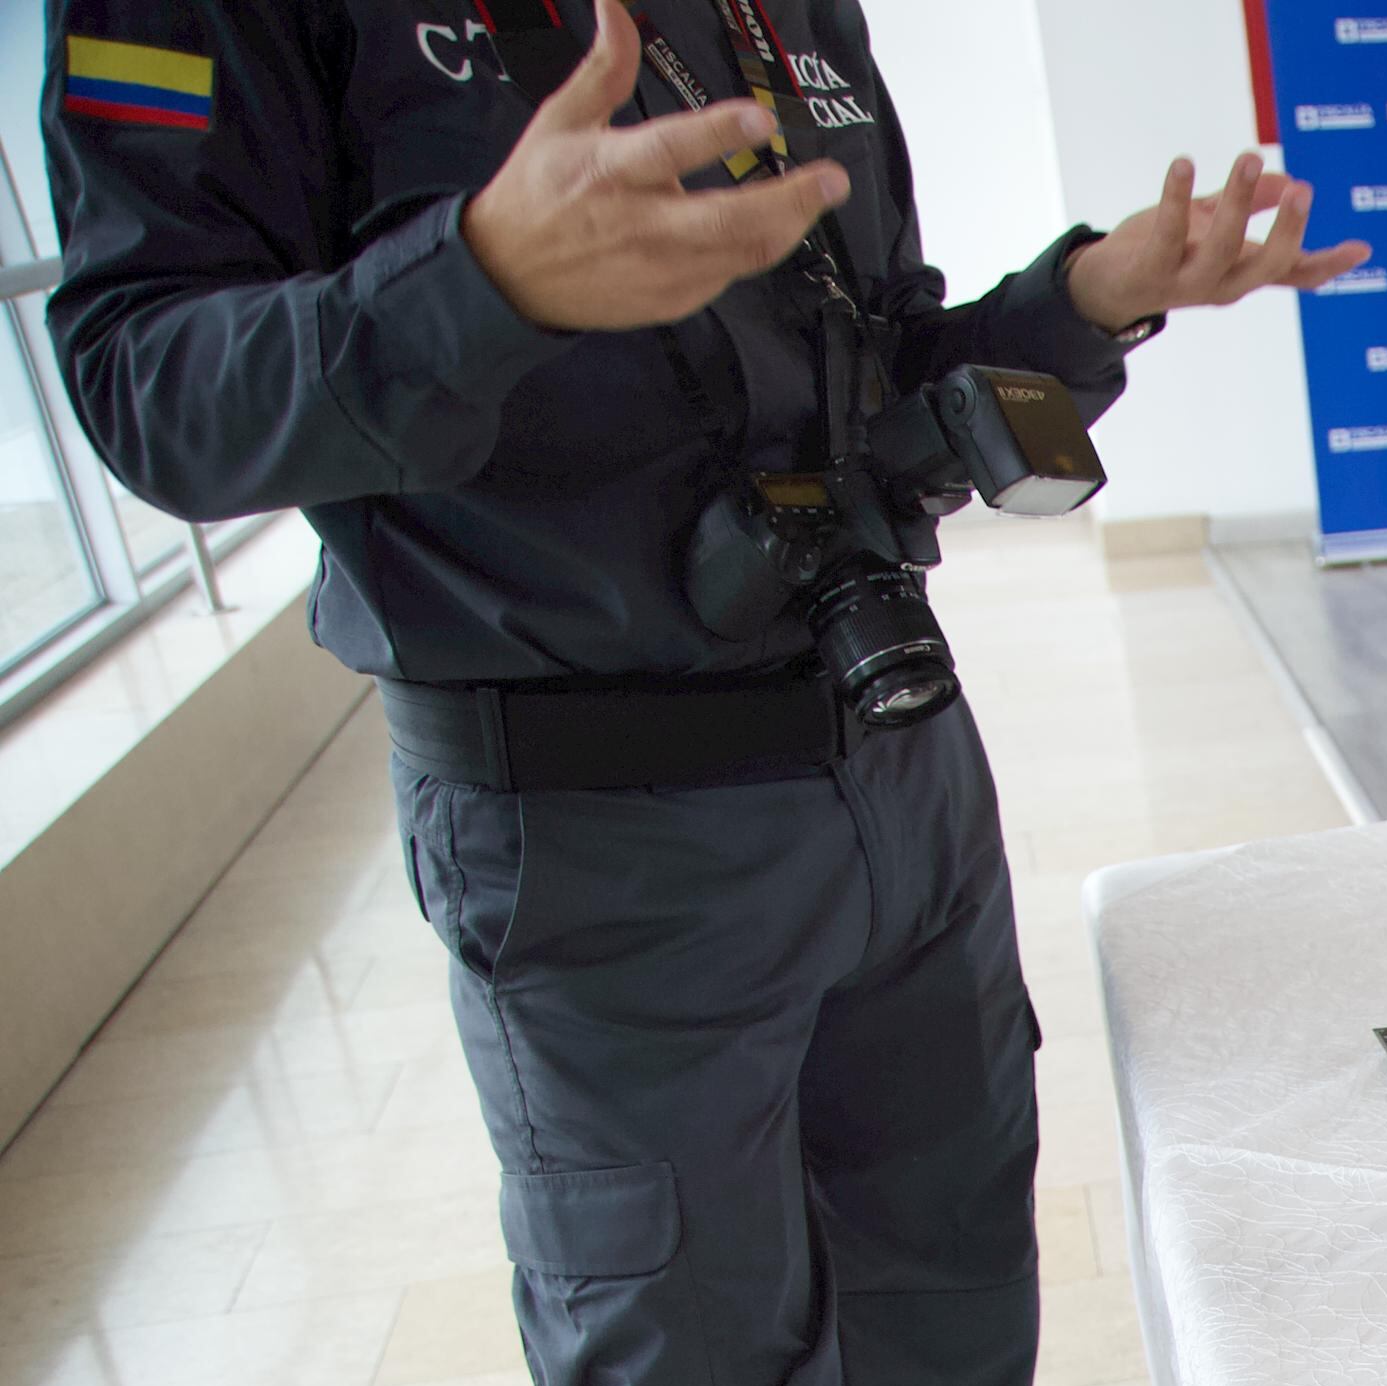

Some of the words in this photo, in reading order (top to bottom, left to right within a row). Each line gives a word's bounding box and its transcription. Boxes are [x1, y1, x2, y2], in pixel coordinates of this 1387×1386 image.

[738, 0, 775, 62] non
[786, 51, 851, 91] ICÍA
[807, 96, 875, 128] CIAL
